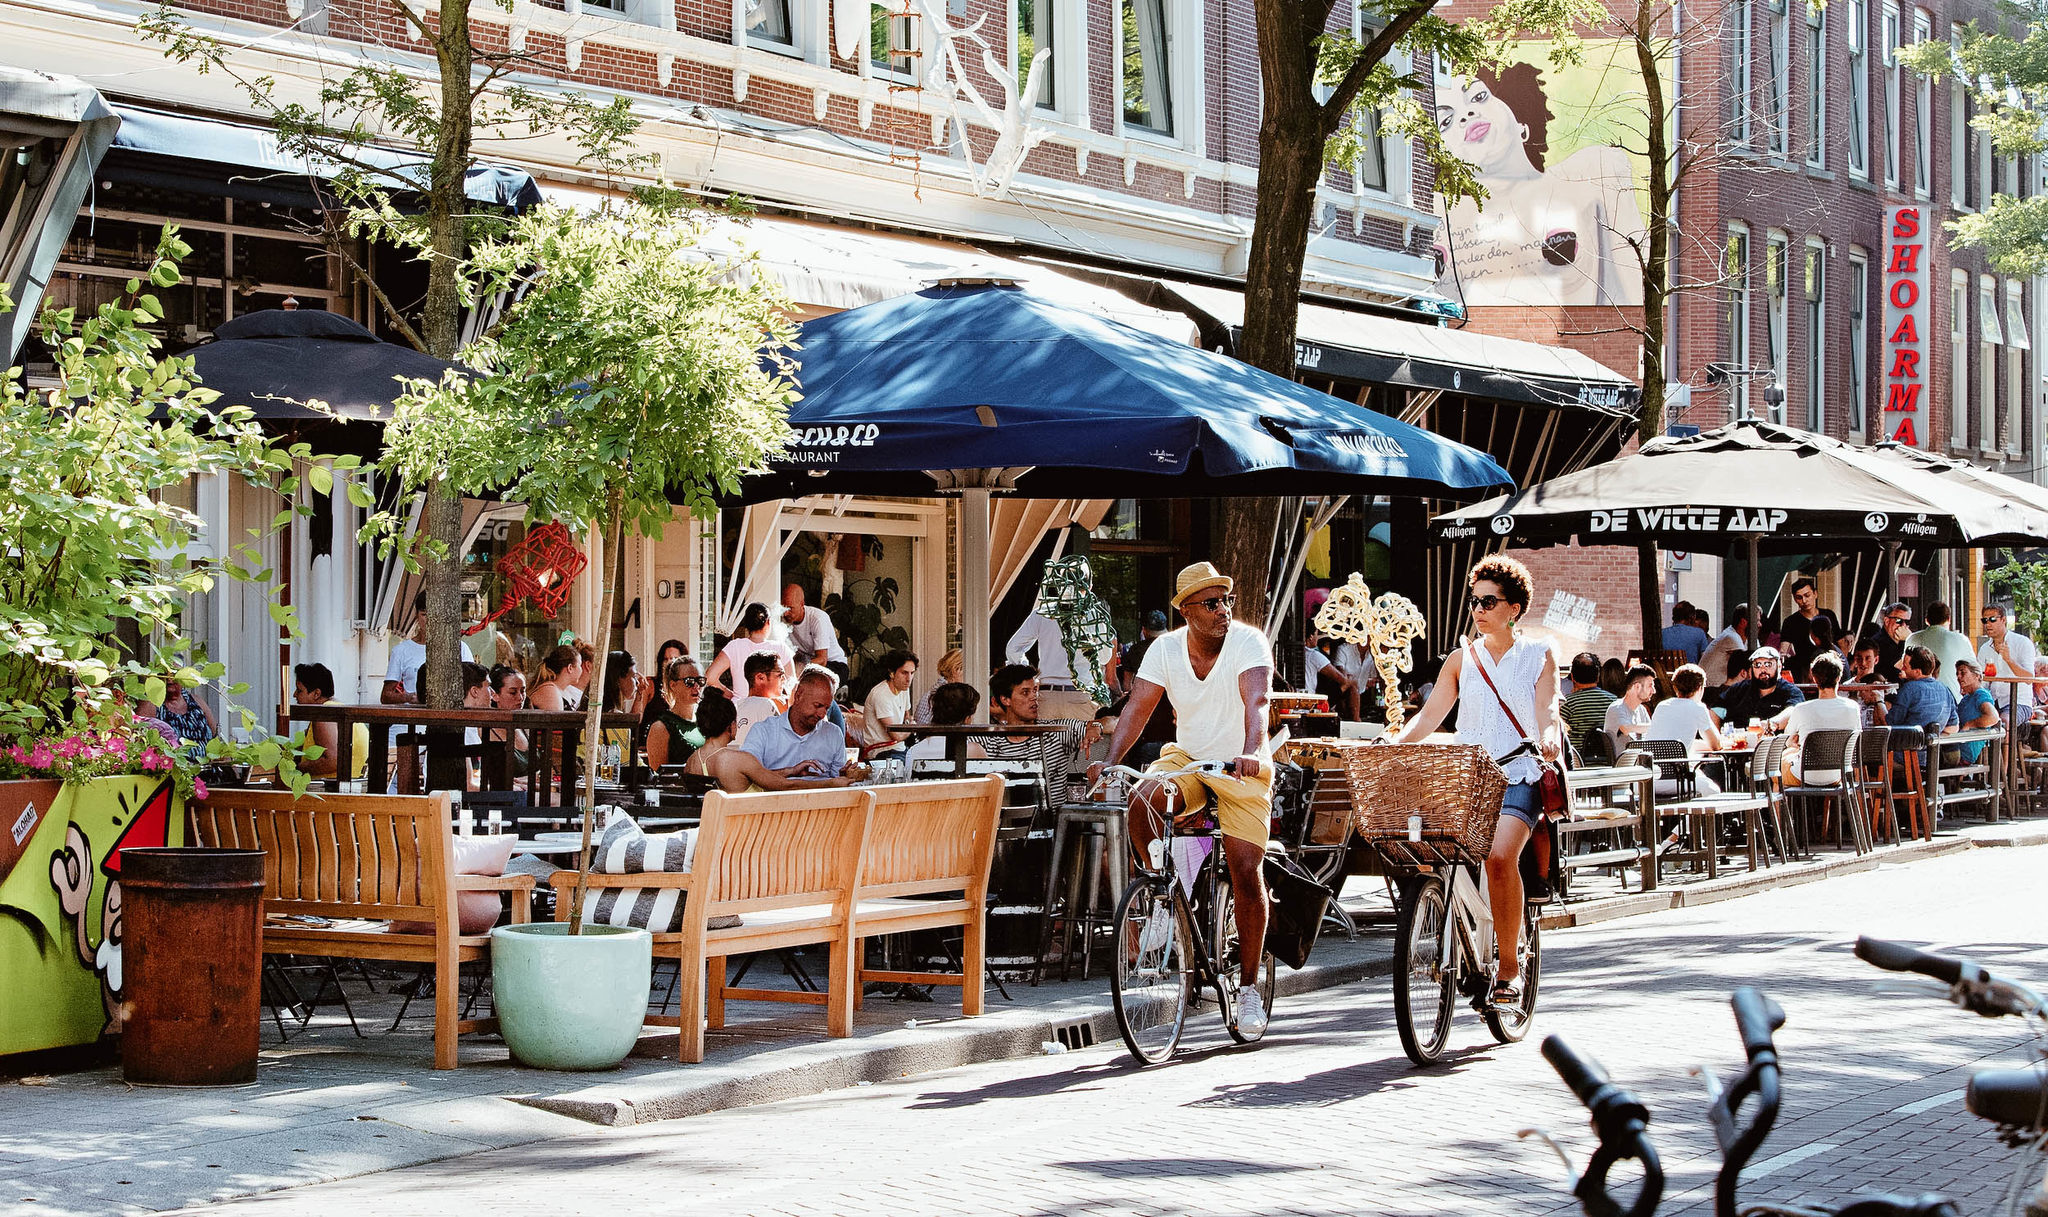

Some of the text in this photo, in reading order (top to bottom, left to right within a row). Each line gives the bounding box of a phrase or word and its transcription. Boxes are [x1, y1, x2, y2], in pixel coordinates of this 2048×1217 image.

[1883, 207, 1924, 447] SHOARMA
[763, 451, 841, 463] RESTAURANT
[1590, 508, 1788, 532] DE WITTE AAP
[1440, 526, 1476, 539] Affligem
[1899, 522, 1938, 536] Affligem
